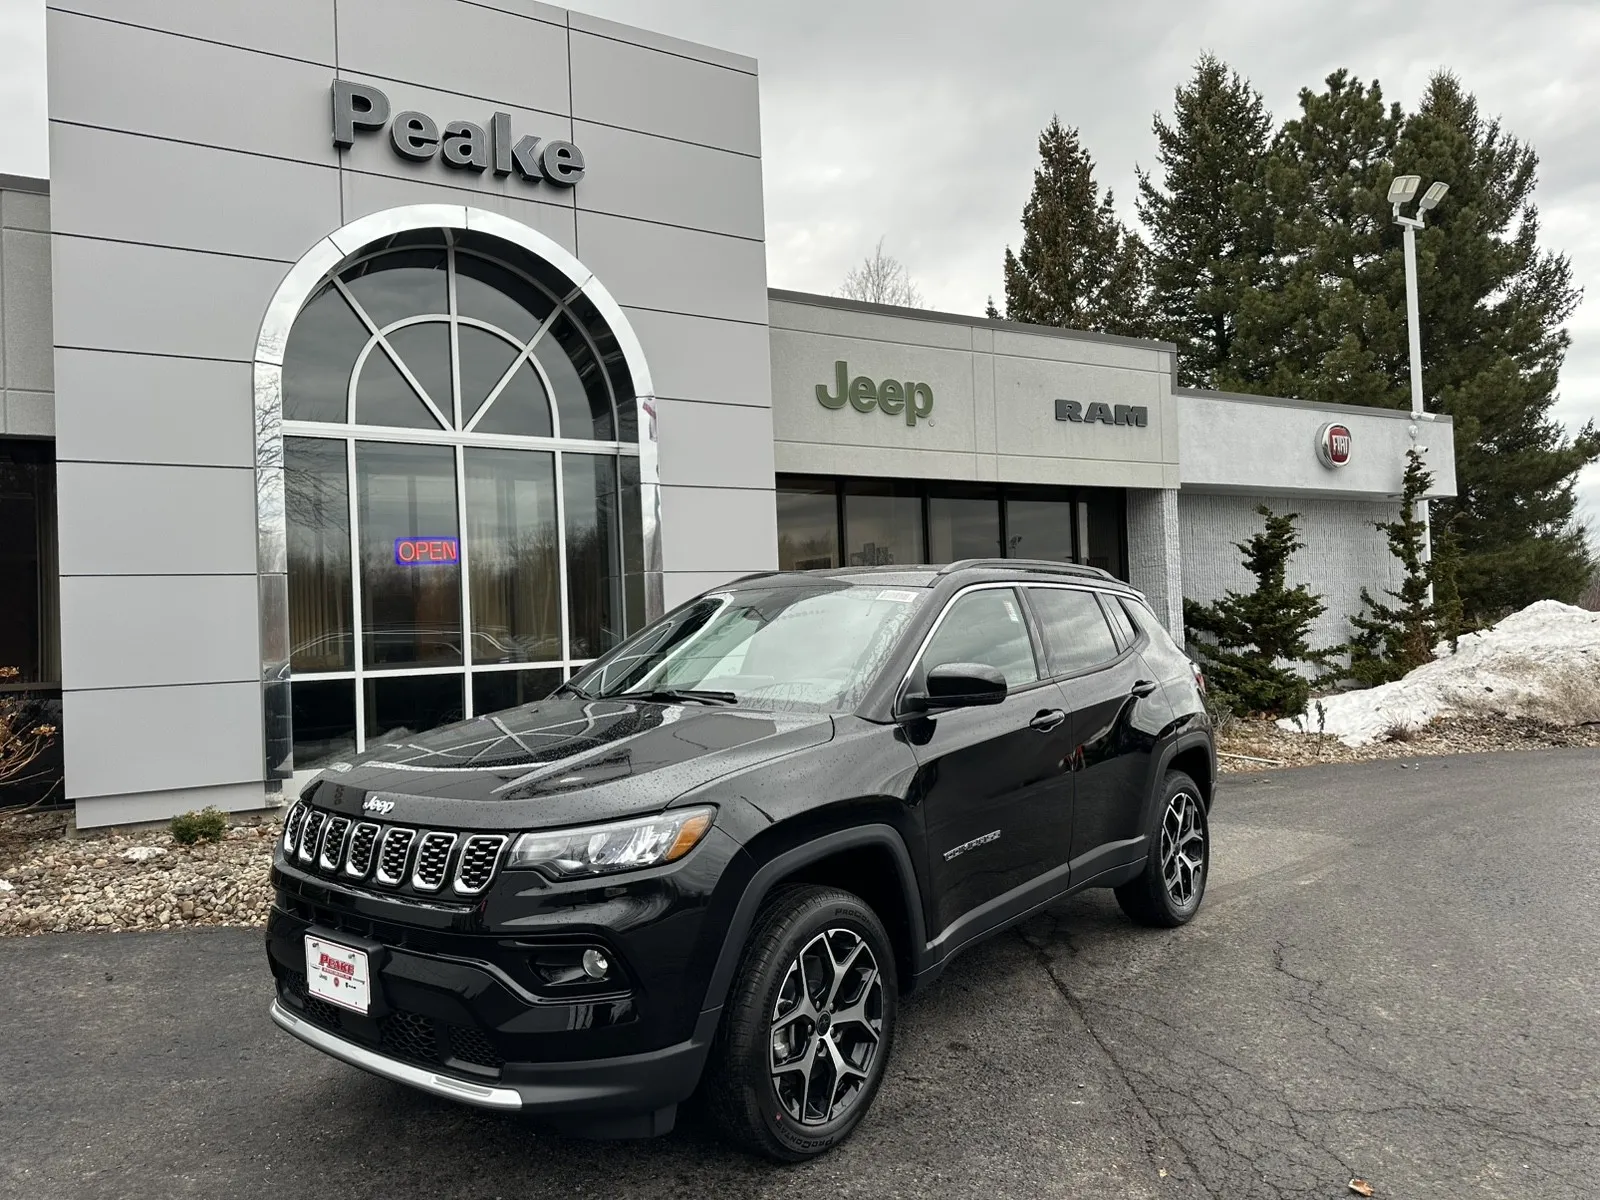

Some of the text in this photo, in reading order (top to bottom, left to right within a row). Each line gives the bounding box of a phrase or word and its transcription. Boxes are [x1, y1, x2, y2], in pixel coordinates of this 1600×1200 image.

[331, 78, 586, 188] Peake
[815, 360, 934, 427] Jeep
[1054, 398, 1148, 427] RAM
[1331, 434, 1350, 456] FIAT
[398, 541, 457, 562] OPEN
[362, 795, 395, 816] Jeep
[319, 952, 355, 976] PEAKE
